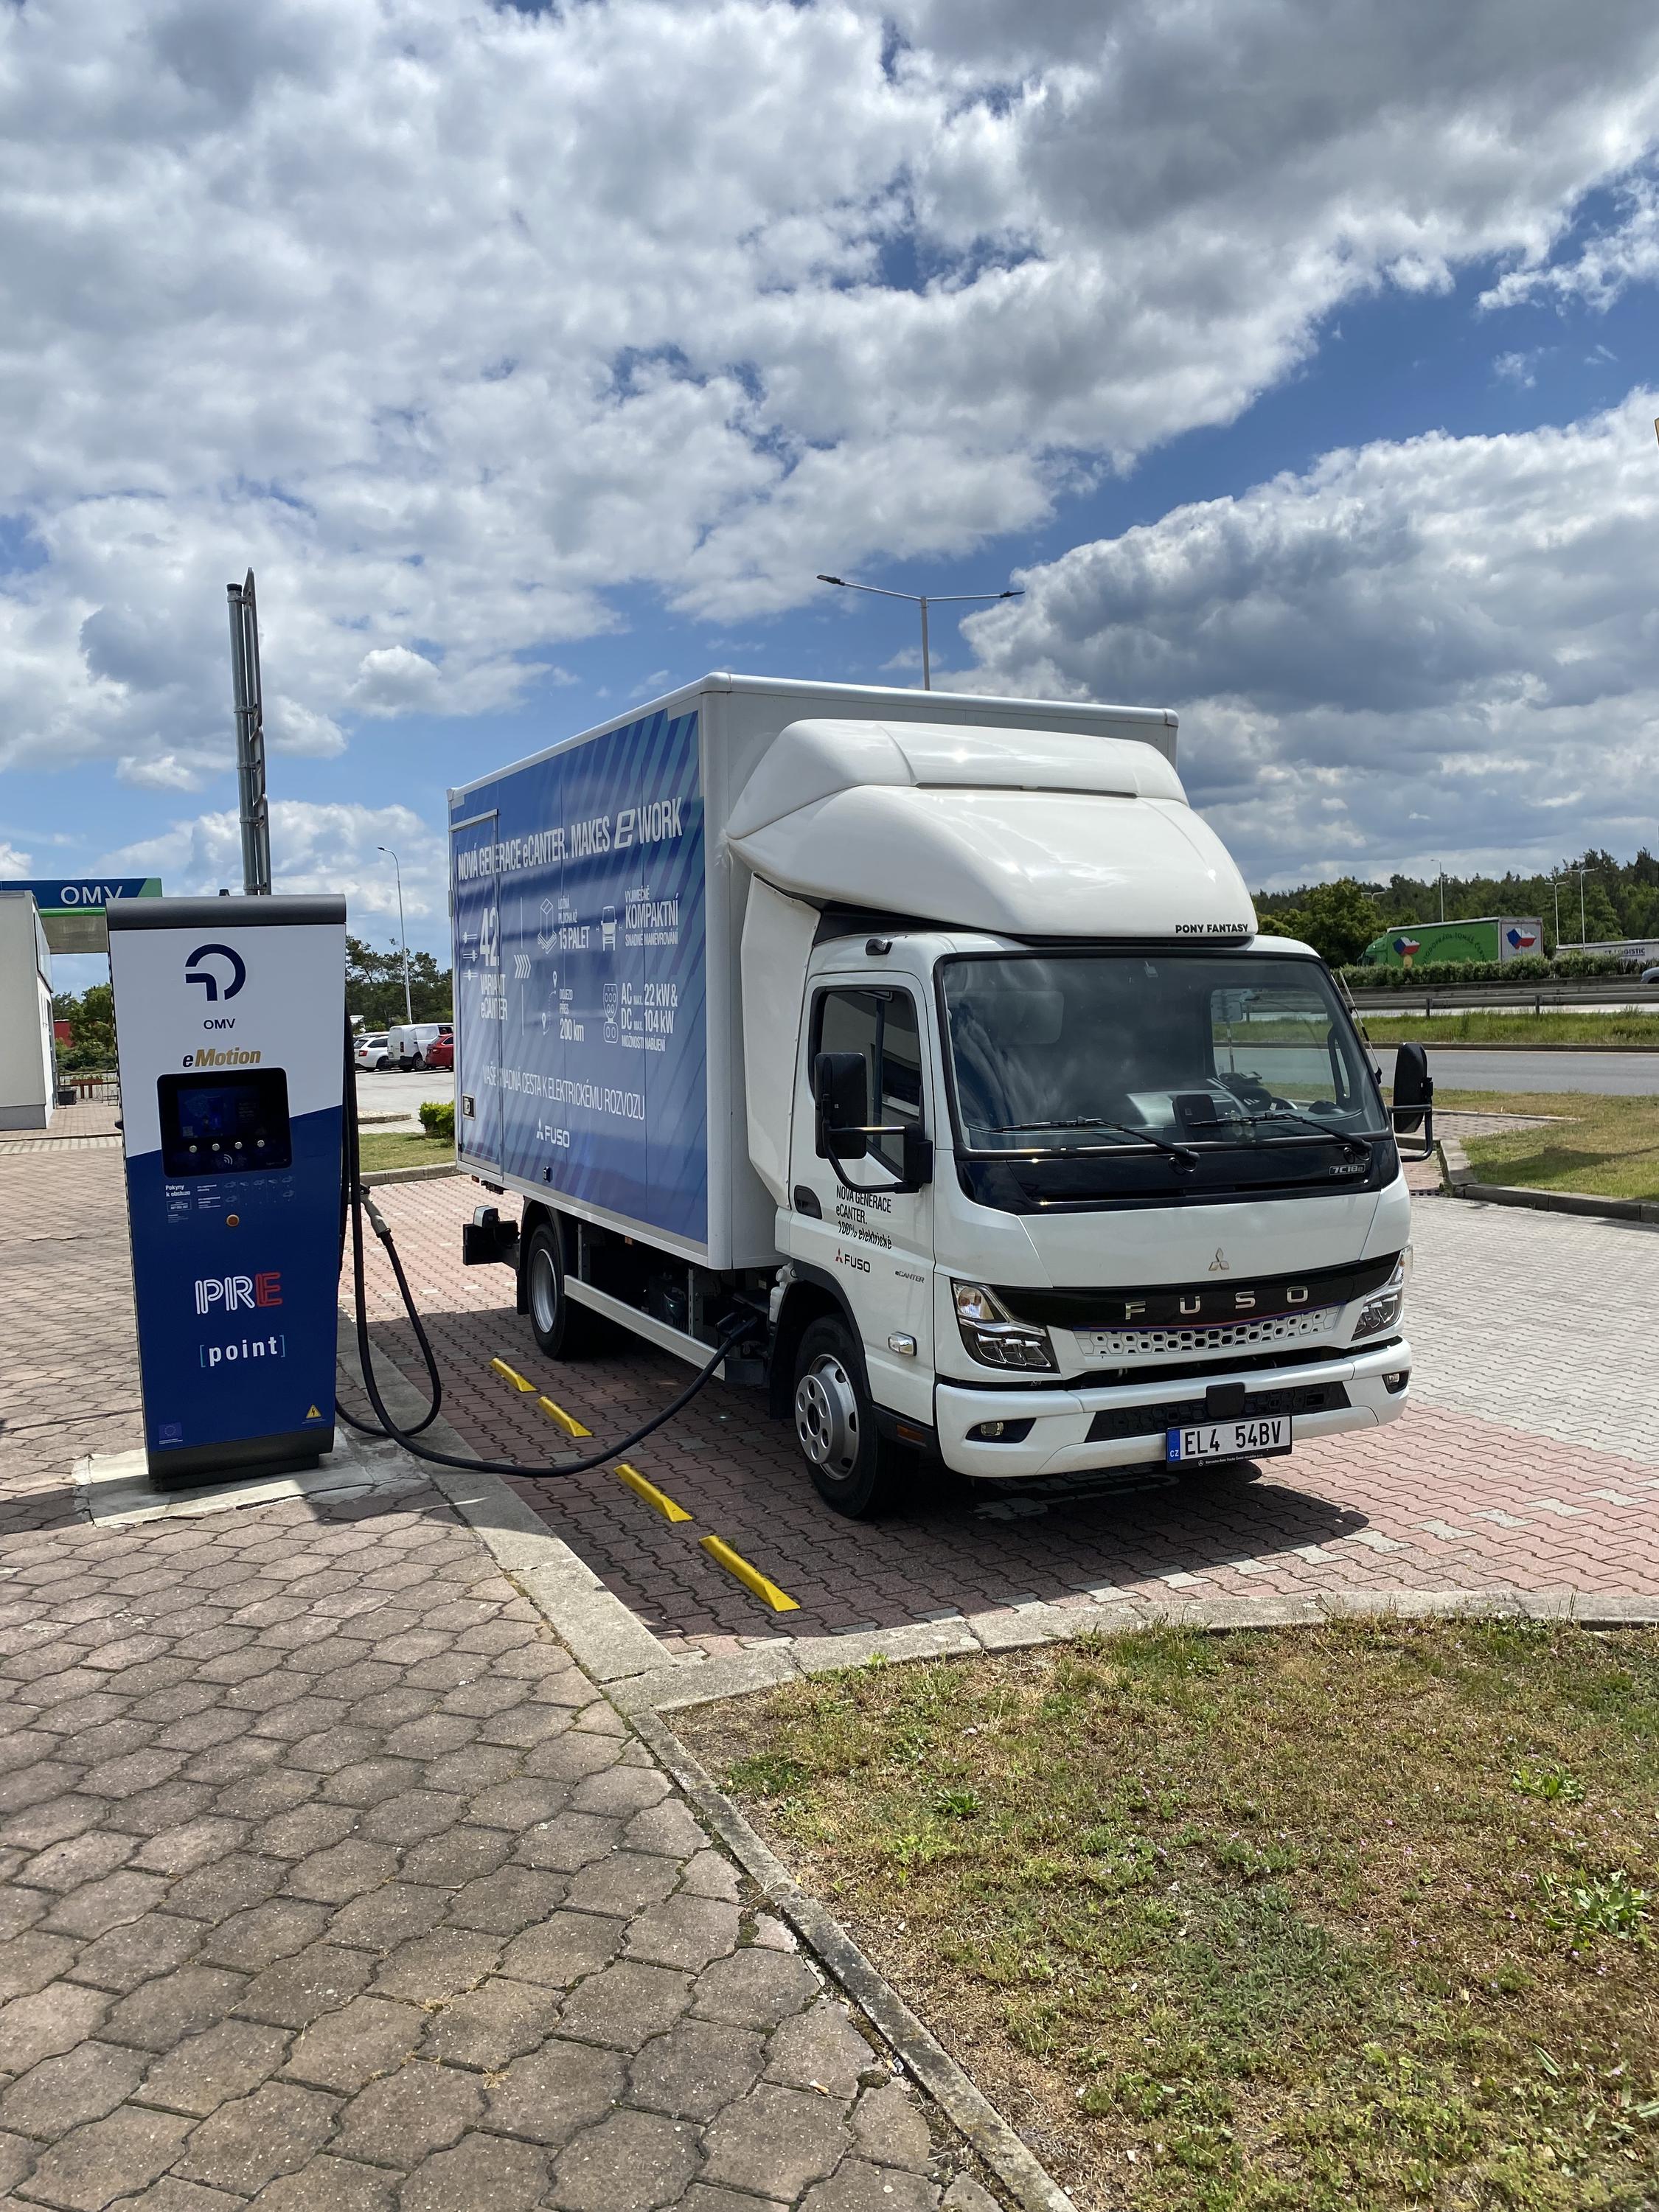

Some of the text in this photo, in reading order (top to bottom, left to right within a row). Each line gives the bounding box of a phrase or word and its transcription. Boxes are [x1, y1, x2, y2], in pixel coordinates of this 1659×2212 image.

[458, 842, 478, 881] NOVÁ
[479, 838, 521, 877] GENERACE
[523, 827, 568, 868] eCANTER.
[571, 815, 611, 858] MAKES
[638, 796, 683, 844] WORK
[60, 886, 123, 904] OMV
[625, 892, 679, 929] KOMPAKTNÍ
[559, 925, 590, 950] 15 PALET
[1175, 923, 1248, 933] PONY FANTASY
[621, 982, 632, 1006] AC
[644, 983, 655, 1006] 22
[656, 983, 670, 1007] kW
[670, 984, 678, 1007] &
[203, 1018, 236, 1030] OMV
[560, 1018, 584, 1042] 200 km
[621, 1007, 632, 1031] DC
[644, 1009, 659, 1032] 104
[660, 1009, 674, 1034] kW
[182, 1047, 261, 1068] eMotion
[522, 1072, 541, 1097] CESTA
[542, 1076, 547, 1097] K
[548, 1077, 602, 1111] ELEKTRICKÉMU
[605, 1088, 645, 1121] ROZVOZU
[545, 1125, 570, 1148] FUSO
[836, 1203, 867, 1224] eCANTER.
[855, 1192, 891, 1214] GENERACE
[838, 1220, 892, 1250] 100% elektrické
[844, 1253, 871, 1273] FUSO
[894, 1270, 925, 1284] eCANTER
[195, 1272, 283, 1315] PRE
[1125, 1286, 1309, 1320] FUSO
[1185, 1420, 1281, 1455] EL4 54BV
[1169, 1449, 1180, 1458] CZ
